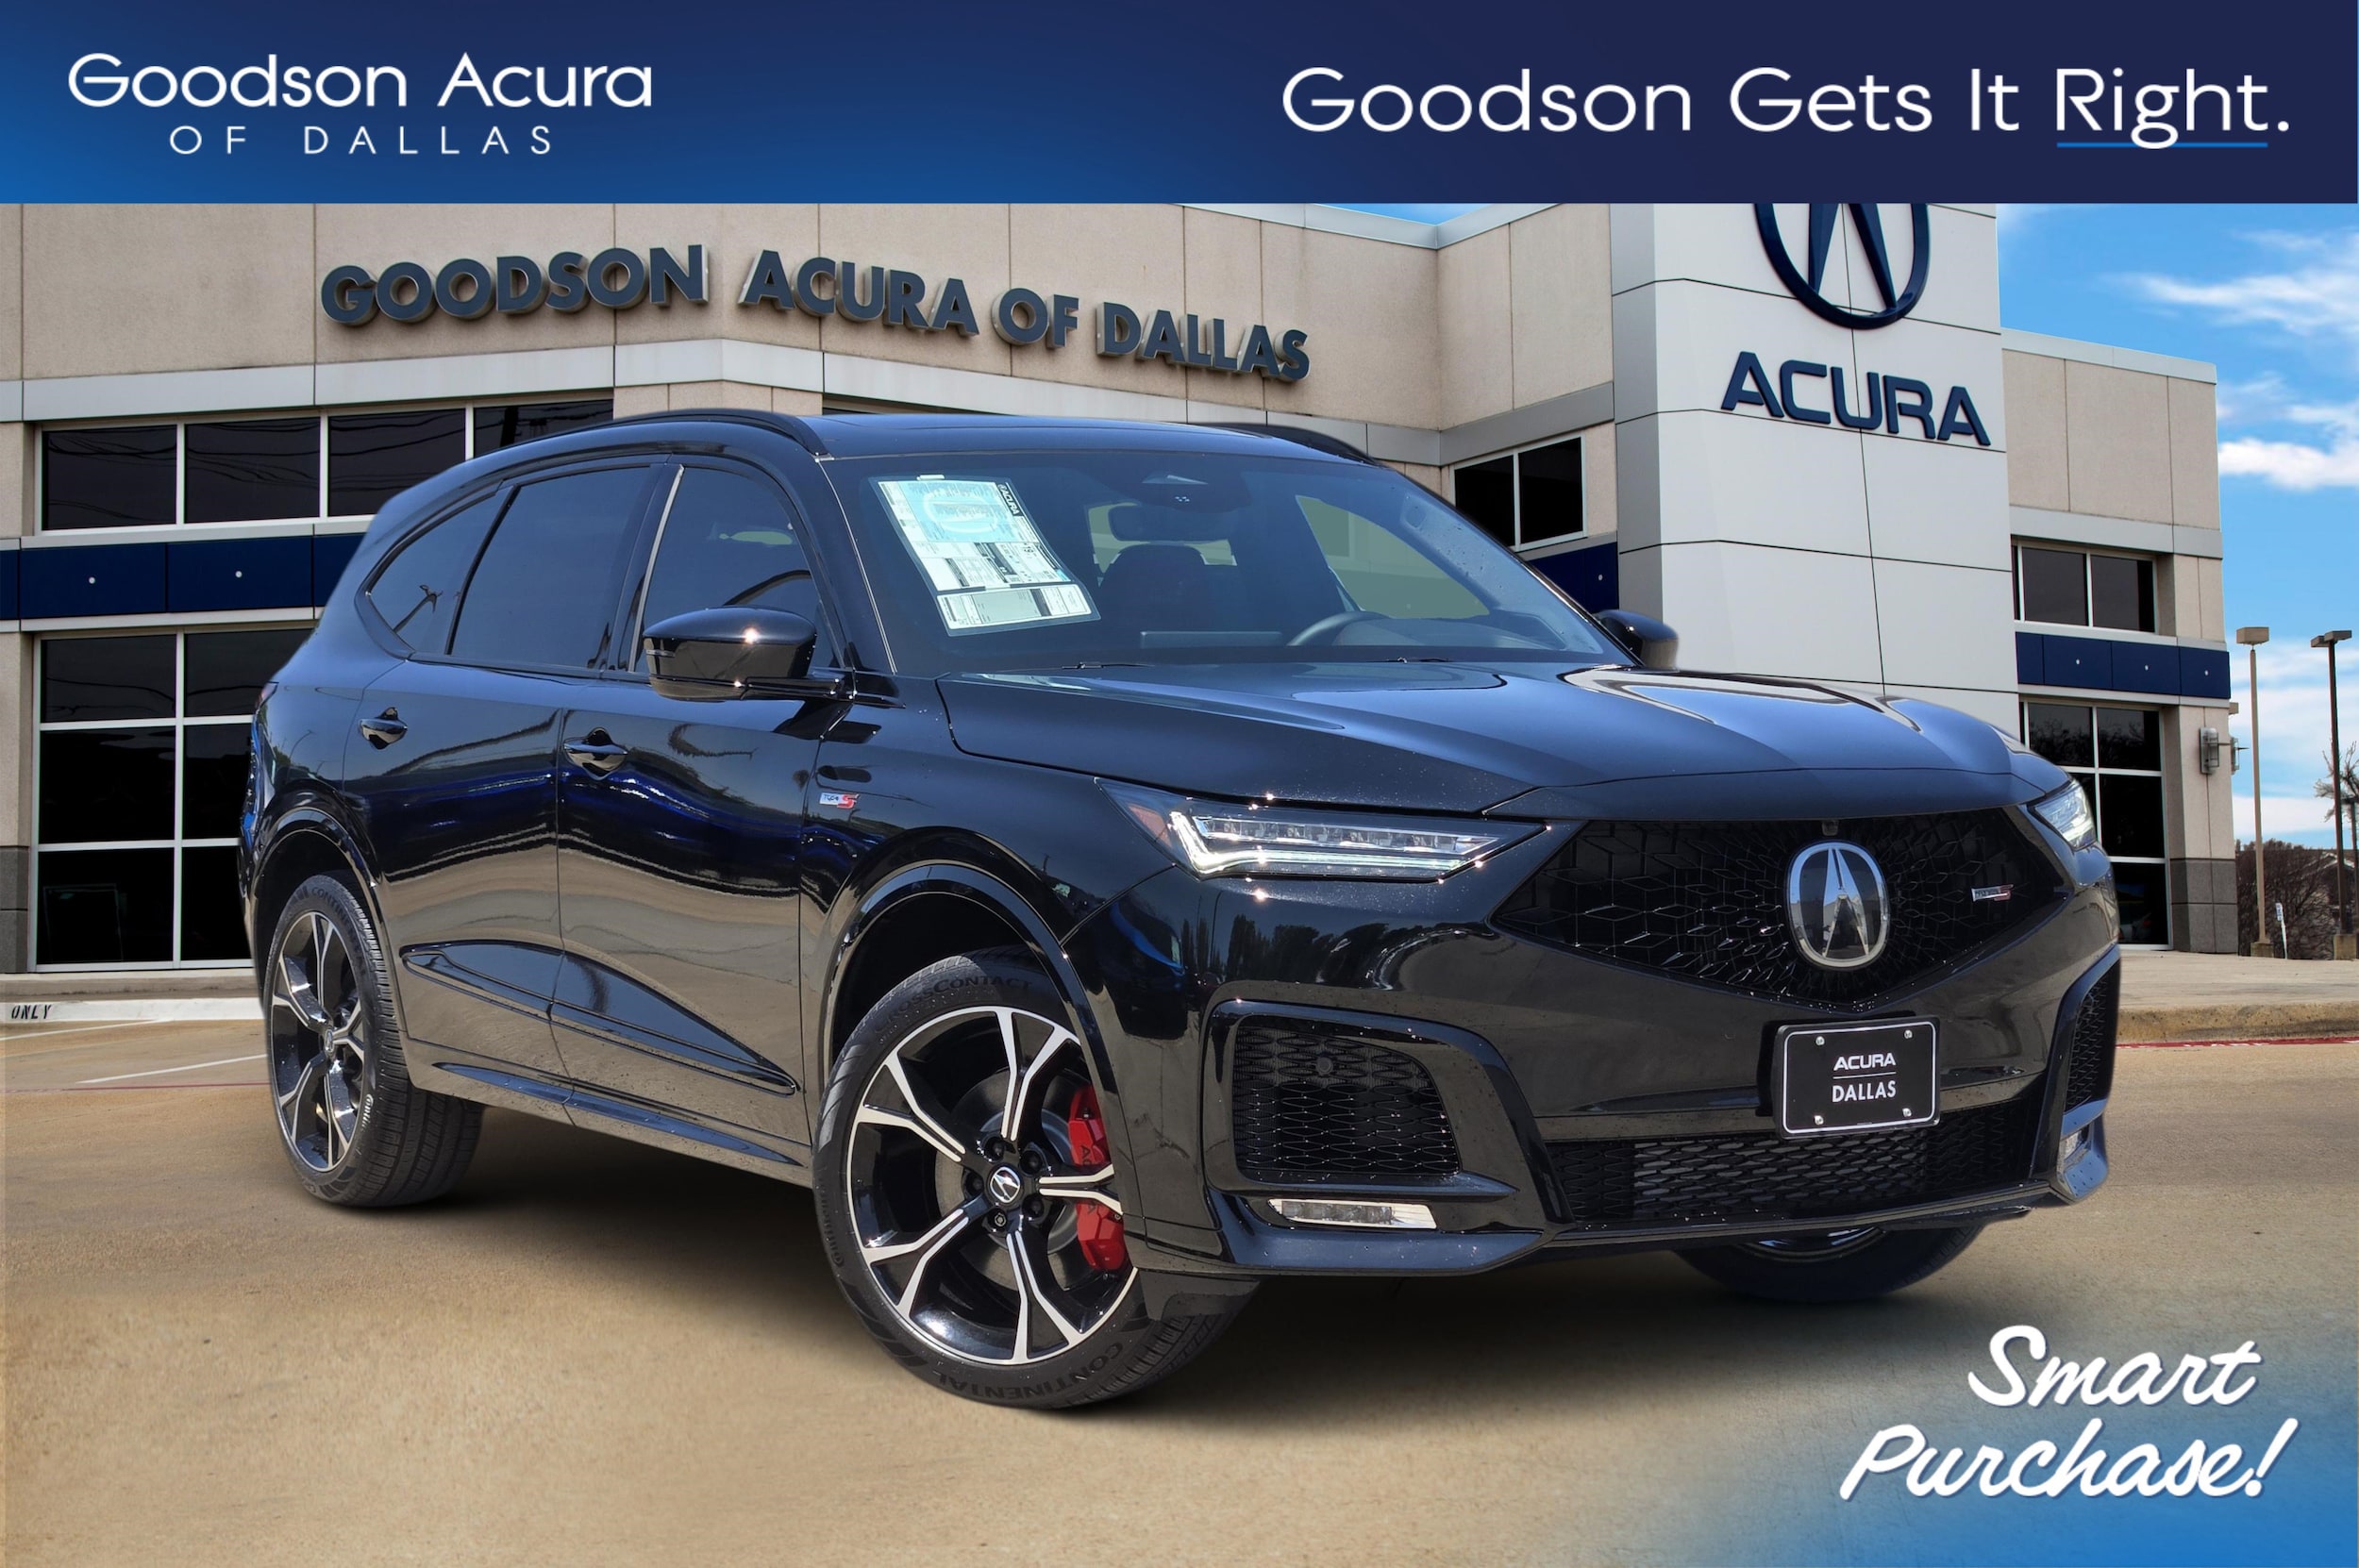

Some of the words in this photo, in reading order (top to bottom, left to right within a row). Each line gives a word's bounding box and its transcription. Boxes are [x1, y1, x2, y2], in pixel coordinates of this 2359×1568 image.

[321, 243, 708, 327] GOODSON
[738, 248, 980, 337] ACURA
[991, 287, 1079, 349] OF
[1096, 300, 1312, 382] DALLAS
[1720, 350, 1992, 447] ACURA
[1000, 489, 1021, 515] ACURA
[10, 1004, 52, 1020] ONLY
[1832, 1052, 1897, 1072] ACURA
[1832, 1079, 1897, 1103] DALLAS
